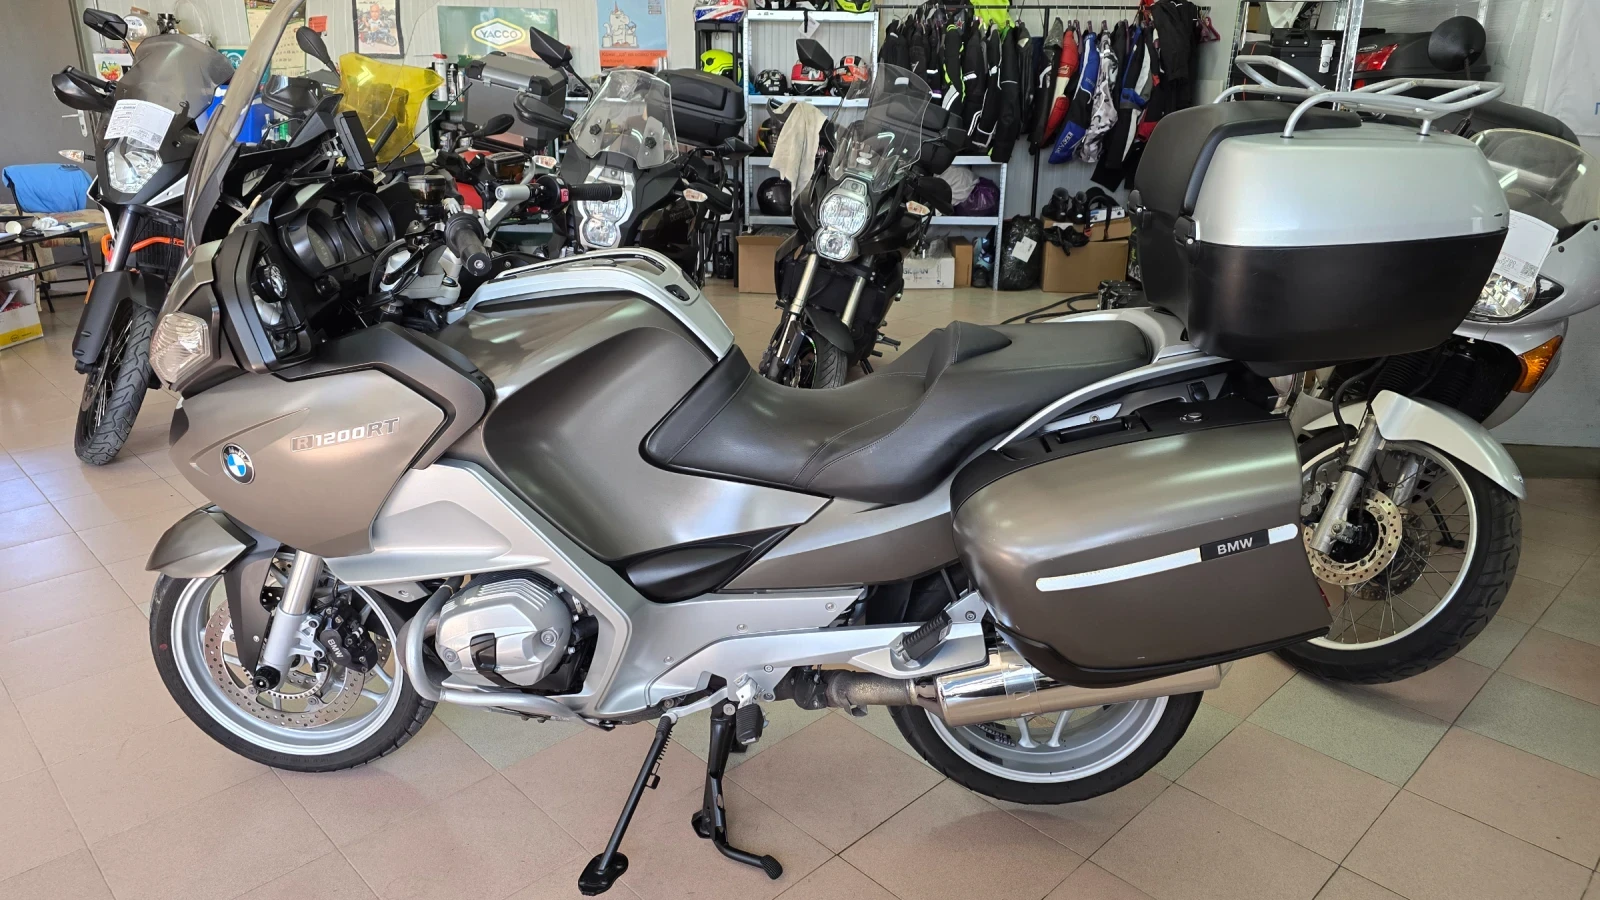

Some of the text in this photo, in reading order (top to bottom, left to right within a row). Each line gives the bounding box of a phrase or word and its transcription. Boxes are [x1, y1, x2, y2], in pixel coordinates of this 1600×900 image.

[480, 30, 518, 39] YACCO
[291, 417, 399, 452] R1200RT
[1217, 537, 1253, 555] BMW
[327, 638, 344, 658] BMW
